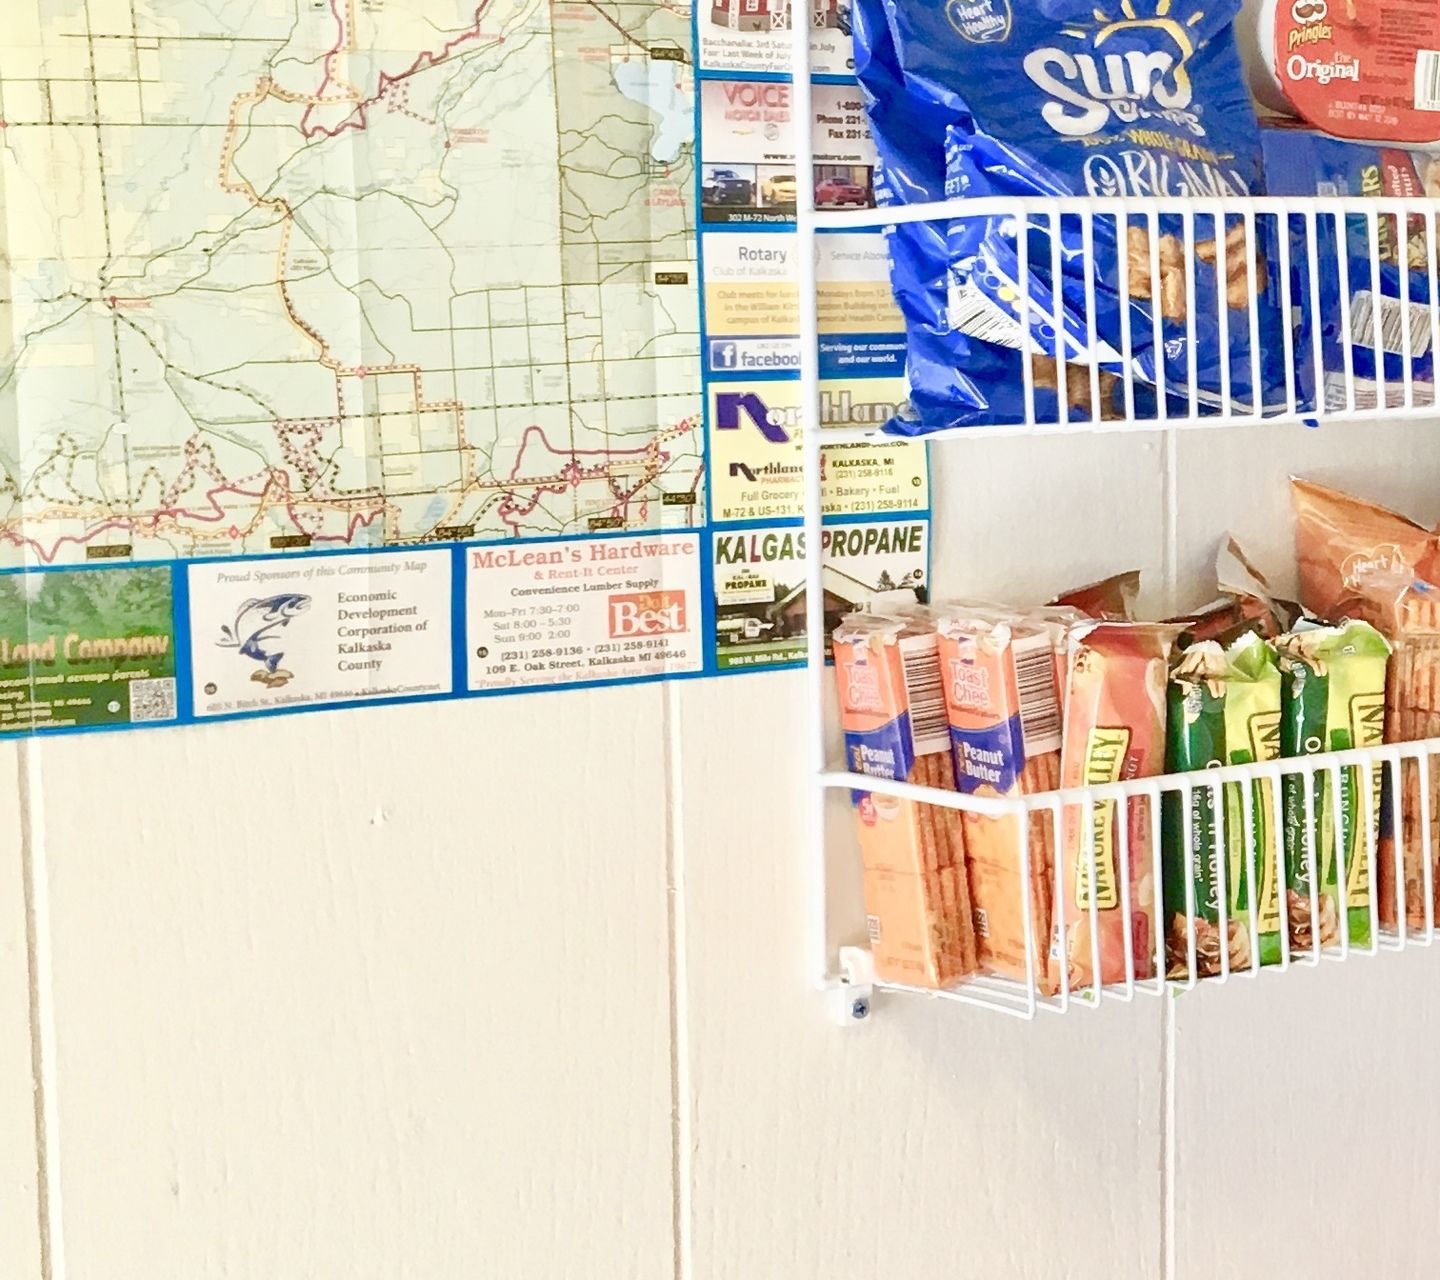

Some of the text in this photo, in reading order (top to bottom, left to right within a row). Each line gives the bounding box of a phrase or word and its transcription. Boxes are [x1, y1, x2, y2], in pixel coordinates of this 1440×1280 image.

[961, 14, 1006, 37] Healthy
[1287, 21, 1334, 53] Pringles
[1286, 53, 1360, 86] Original
[723, 84, 790, 108] VOICE
[1021, 46, 1194, 137] Sun
[738, 246, 787, 264] Rotary
[740, 485, 900, 504] Full Grocery Bakery Fuel
[472, 539, 696, 570] McLean's Hardware
[715, 525, 924, 565] KALGAS PROPANE
[533, 570, 545, 581] &
[596, 564, 639, 577] Center
[1351, 554, 1390, 575] Heart
[510, 577, 660, 598] Convenience Lumber Supply
[725, 579, 768, 590] PROPANE
[337, 589, 398, 604] Economic
[337, 604, 418, 621] Development
[610, 596, 686, 639] Best
[336, 620, 429, 639] Corporation of
[492, 620, 511, 632] Sat
[513, 619, 538, 631] 8:00
[337, 640, 392, 655] Kalkaska
[493, 629, 572, 645] Sun 9:00 2:00
[63, 633, 170, 666] Company
[337, 658, 383, 673] County
[485, 664, 507, 675] 109
[509, 664, 521, 674] E.
[523, 660, 546, 673] Oak
[587, 654, 636, 668] Kalkaska
[949, 660, 990, 686] Toast
[952, 682, 990, 708] Chee
[859, 742, 896, 766] Peanut
[962, 740, 1006, 768] Peanut
[963, 762, 1003, 786] Butter
